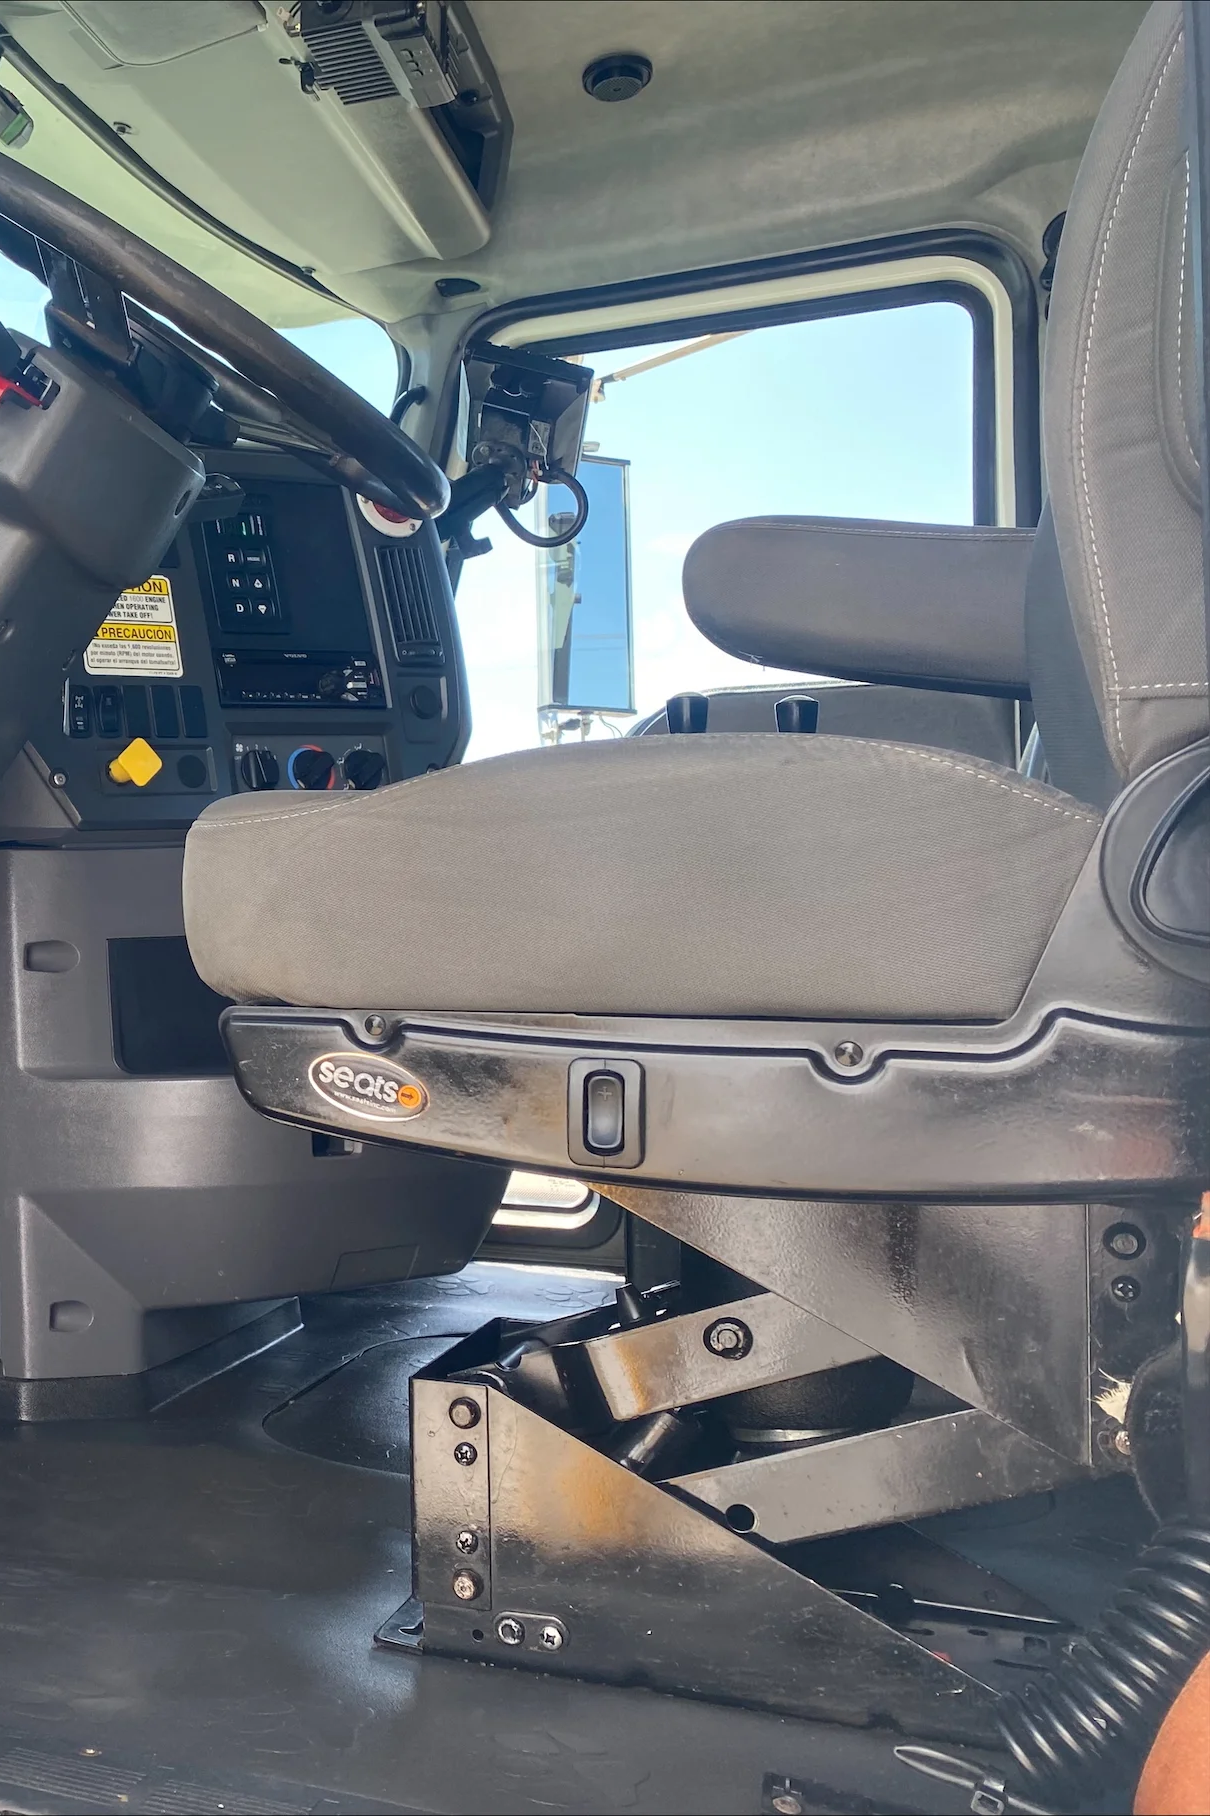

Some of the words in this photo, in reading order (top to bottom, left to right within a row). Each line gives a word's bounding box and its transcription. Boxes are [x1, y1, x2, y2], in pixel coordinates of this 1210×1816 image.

[227, 553, 236, 563] R
[231, 578, 241, 588] N
[145, 596, 166, 604] ENGINE
[126, 603, 159, 611] OPERATING
[235, 603, 245, 613] D
[101, 626, 172, 640] PRECAUCIÓN
[318, 1061, 399, 1103] seats
